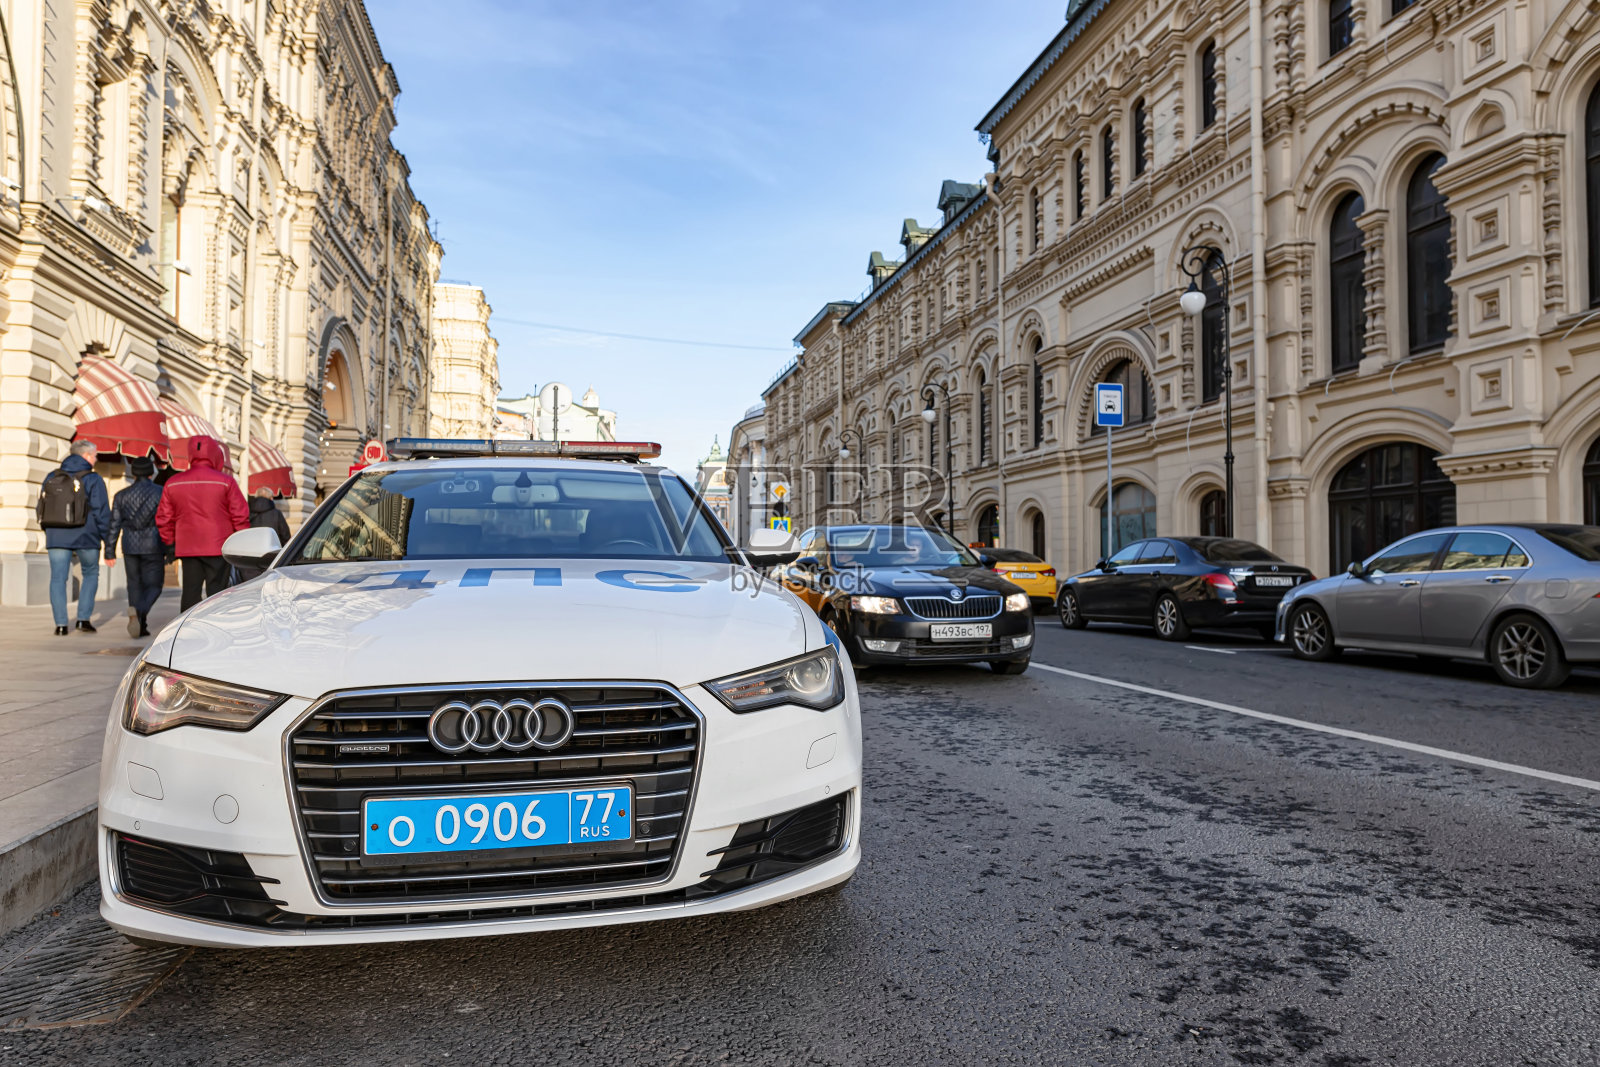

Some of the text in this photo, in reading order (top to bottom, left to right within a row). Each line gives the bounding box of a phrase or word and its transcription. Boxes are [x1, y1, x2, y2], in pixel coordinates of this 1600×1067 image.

[435, 799, 547, 845] 0906
[575, 792, 616, 825] 77
[580, 825, 611, 838] RUS
